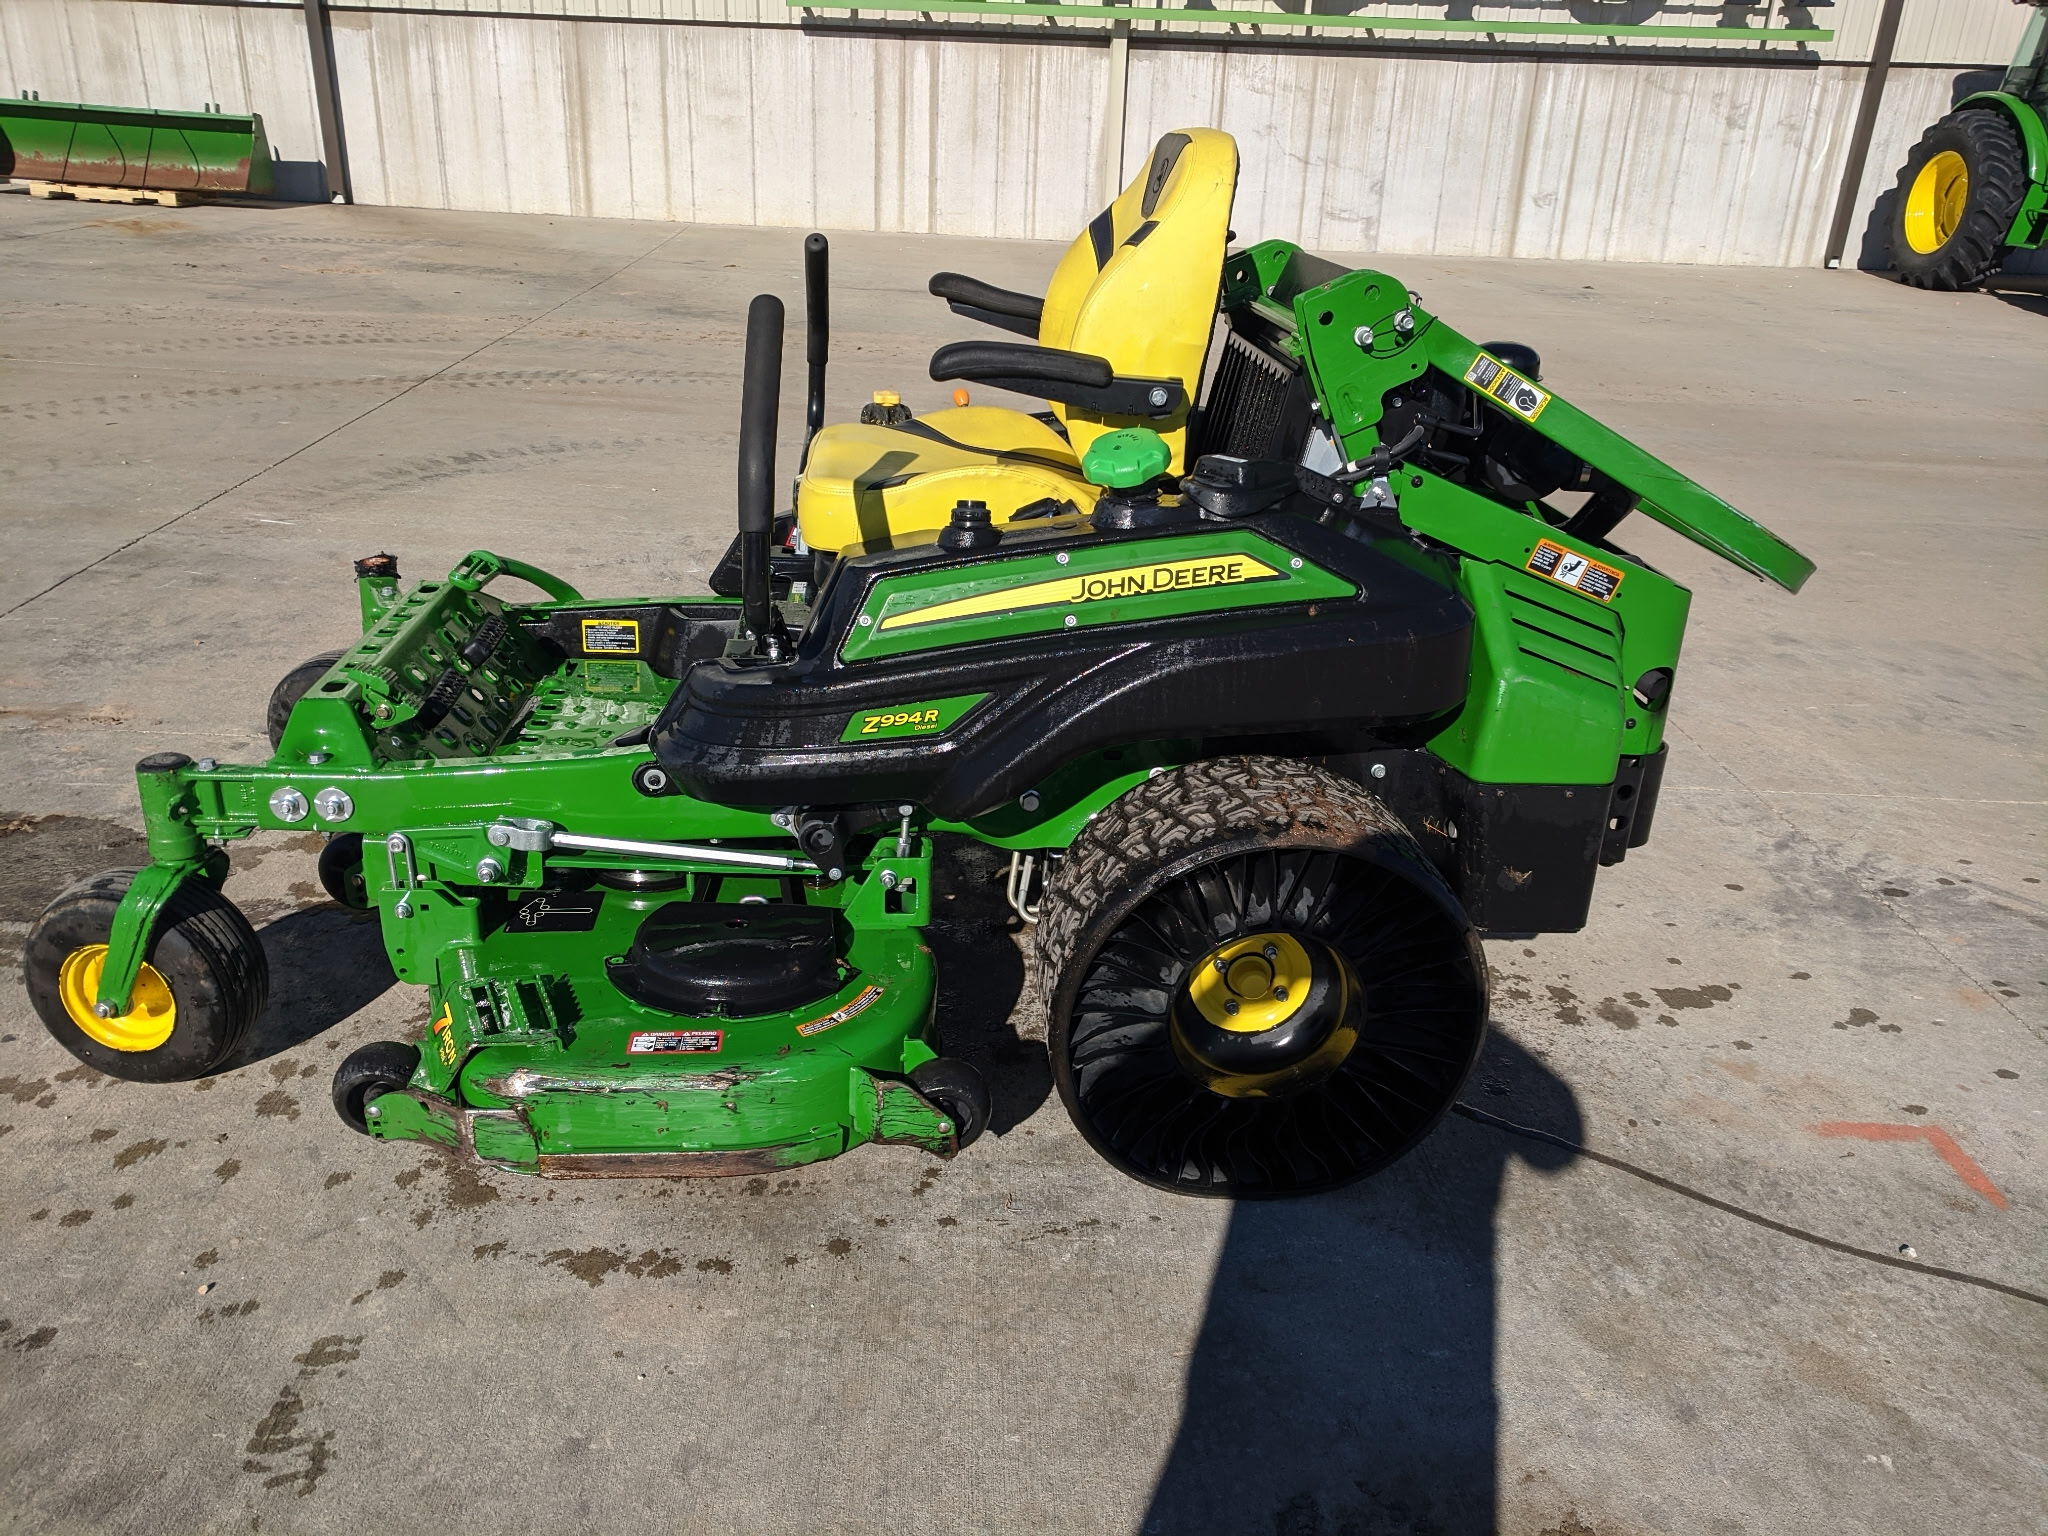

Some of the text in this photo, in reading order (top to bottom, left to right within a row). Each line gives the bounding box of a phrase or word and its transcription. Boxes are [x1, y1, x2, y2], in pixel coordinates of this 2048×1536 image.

[1071, 562, 1243, 600] JOHN DEERE
[861, 709, 939, 734] Z994R
[914, 723, 938, 731] Diesel
